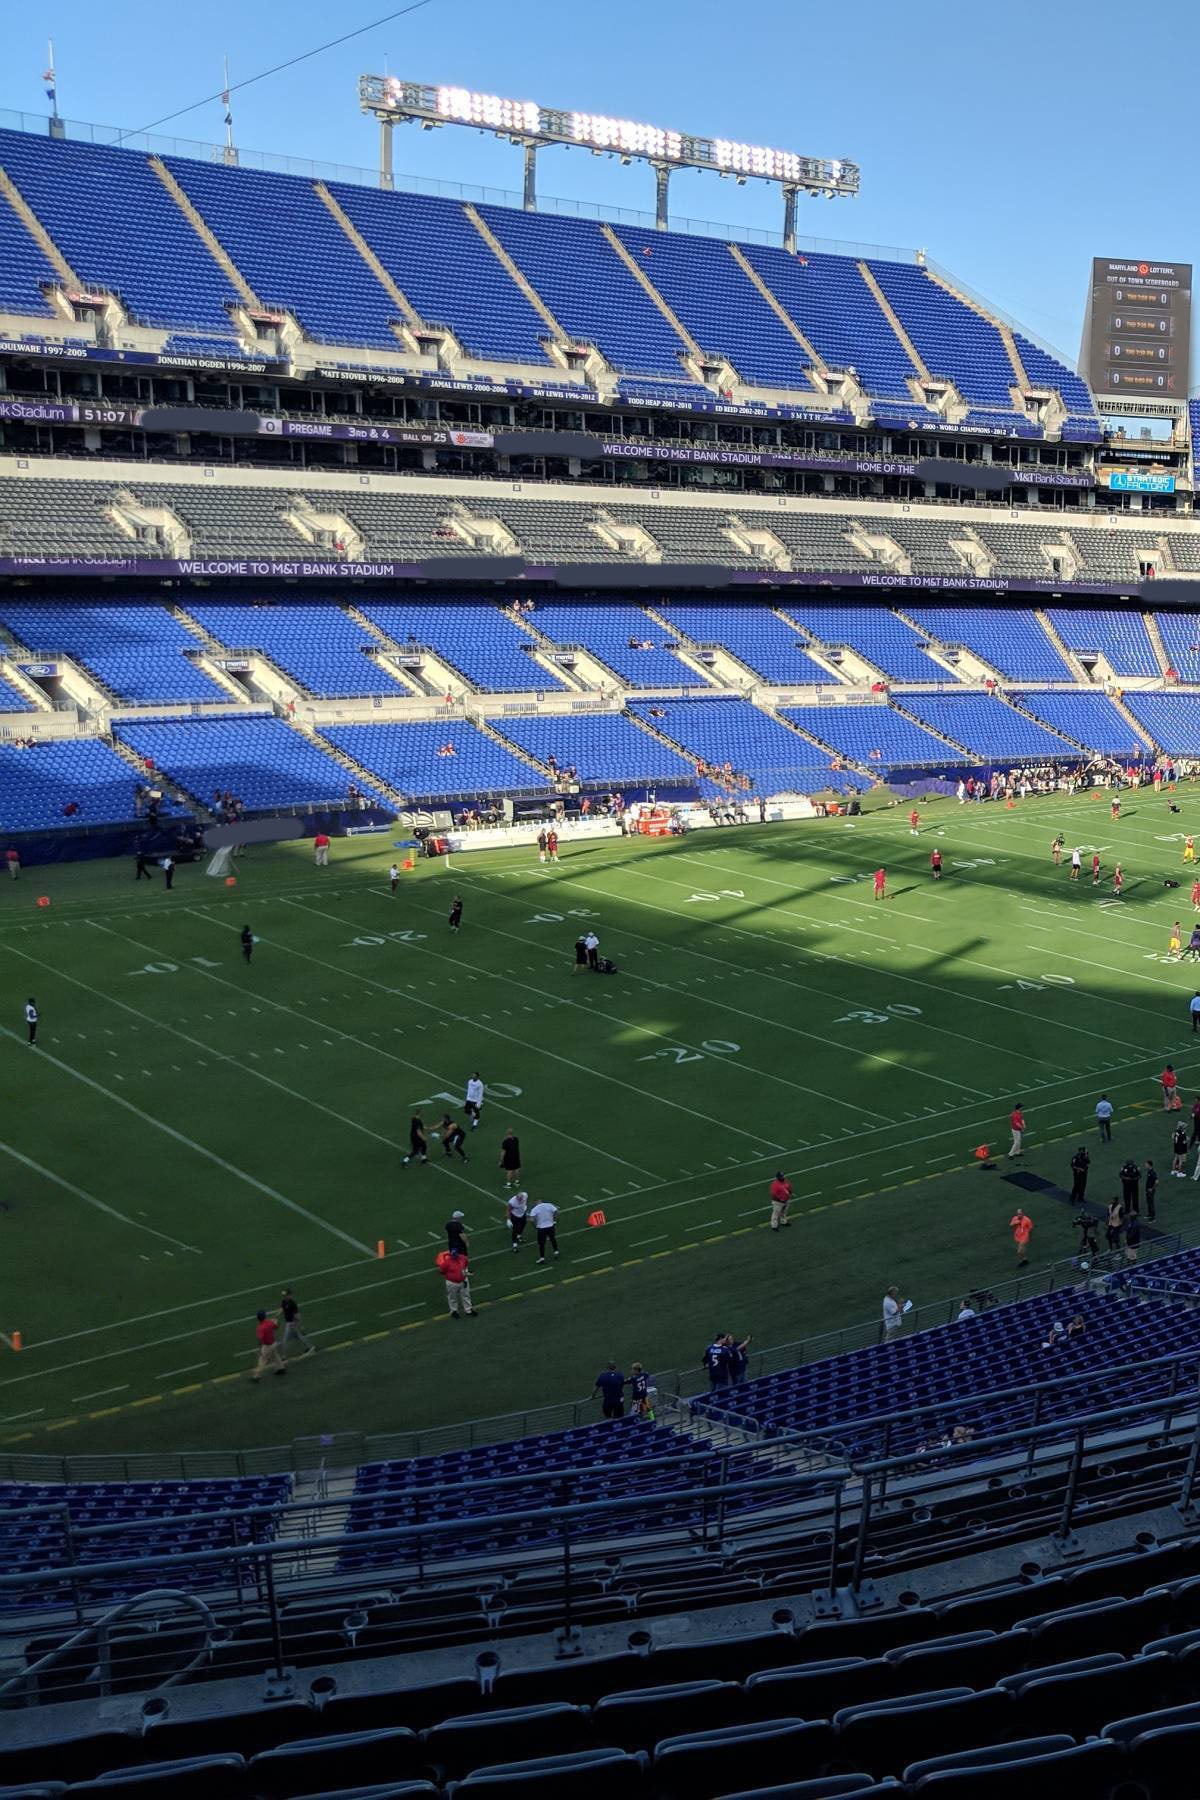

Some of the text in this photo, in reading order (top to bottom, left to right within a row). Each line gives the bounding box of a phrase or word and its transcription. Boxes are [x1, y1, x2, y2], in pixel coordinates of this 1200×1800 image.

[1109, 264, 1175, 275] MARYLAND LOTTERY
[1106, 275, 1118, 283] OUT
[1128, 277, 1144, 285] TOWN
[1145, 279, 1180, 287] SCOREBOARD
[1116, 291, 1122, 300] 0
[1161, 294, 1167, 303] 0
[1116, 319, 1121, 328] 0
[1160, 322, 1165, 331] 0
[0, 341, 88, 358] OULWARE 1997-2005
[1114, 346, 1120, 355] 0
[1159, 349, 1164, 358] 0
[157, 355, 266, 373] JONATHAN OGDEN 1996-2007
[320, 369, 405, 385] MATT STOVER 1996-2008
[1114, 374, 1119, 383] 0
[1158, 377, 1163, 386] 0
[430, 380, 509, 394] JAMAL LEWIS 2000-2006
[533, 389, 596, 401] RAY LEWIS 1996-2012
[627, 397, 693, 410] TODD HEAP 2001-2010
[11, 404, 64, 420] Stadium
[84, 410, 126, 422] 51:07
[723, 406, 738, 414] REED
[739, 407, 768, 416] 2002-2012
[790, 411, 820, 422] SMYTH
[288, 423, 332, 436] PREGAME
[348, 427, 367, 438] 3RD
[370, 428, 379, 439] &
[381, 429, 390, 440] 4
[402, 432, 420, 442] BALL
[433, 432, 447, 443] 25
[939, 424, 958, 432] WORLD
[959, 425, 991, 435] CHAMPIONS
[993, 427, 1007, 436] 2012
[602, 444, 652, 457] WELCOME
[655, 446, 669, 458] TO
[670, 448, 692, 460] M&T
[694, 450, 719, 462] BANK
[721, 452, 761, 464] STADIUM
[856, 462, 915, 474] HOME OF THE
[1014, 471, 1089, 487] M&T Bank Stadium
[1126, 475, 1170, 483] STRATEGIC
[1126, 482, 1170, 490] FACTORY
[178, 561, 395, 577] WELCOME TO M&T BANK STADIUM
[861, 575, 1009, 590] WELCOME TO M&T BANK STADIUM
[848, 1003, 923, 1024] 30
[655, 1039, 741, 1064] 20
[711, 1354, 719, 1367] 5
